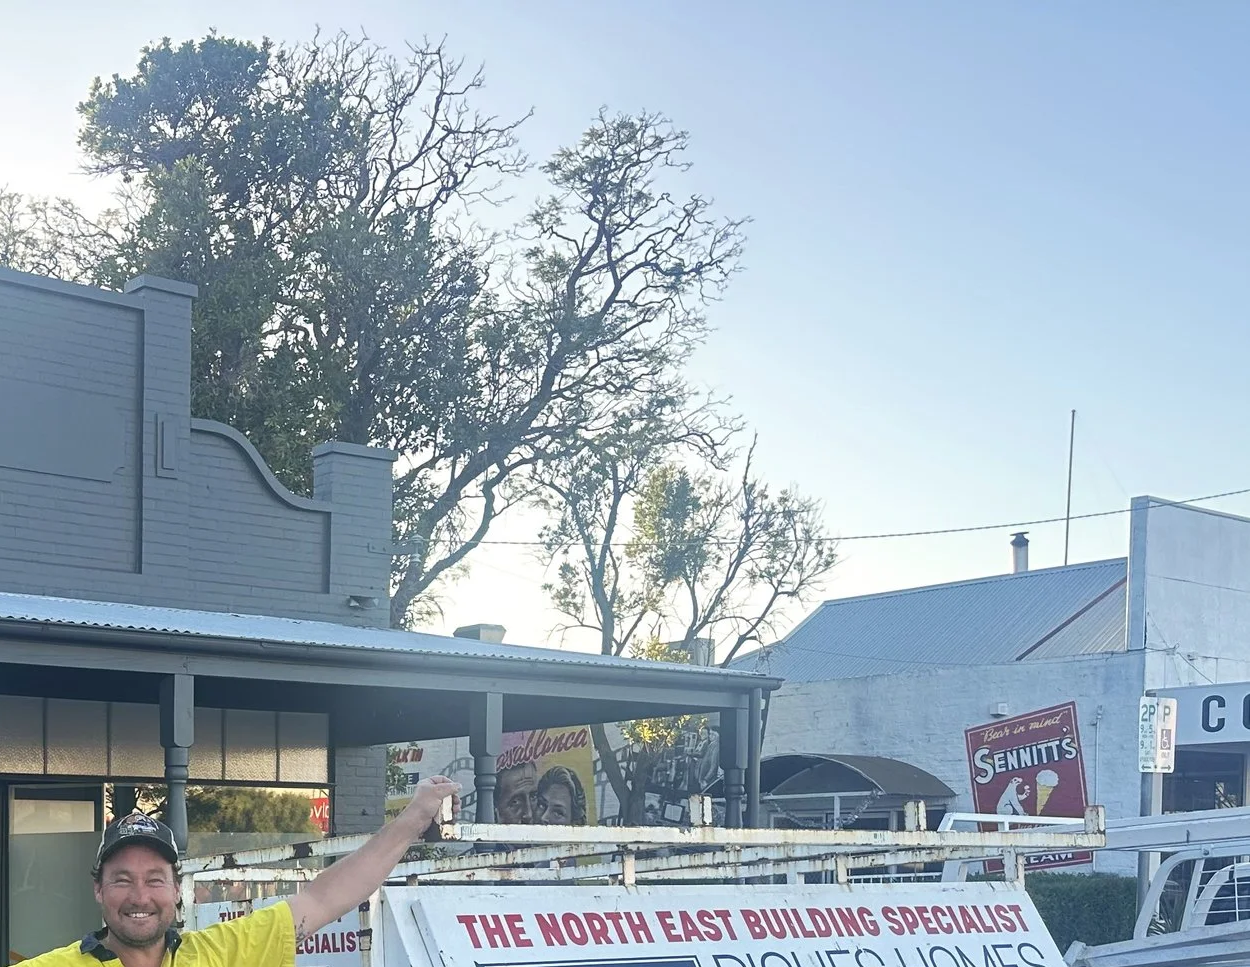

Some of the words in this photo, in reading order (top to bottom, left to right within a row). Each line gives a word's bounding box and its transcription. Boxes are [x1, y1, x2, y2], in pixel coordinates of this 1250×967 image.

[1141, 704, 1155, 722] 2P
[1163, 705, 1171, 722] P
[1012, 724, 1025, 734] in
[496, 728, 587, 772] asablanca
[456, 914, 533, 949] THE
[534, 911, 655, 946] NORTH
[655, 909, 738, 943] EAST
[740, 905, 881, 941] BUILDING
[881, 904, 1029, 936] SPECIALIST
